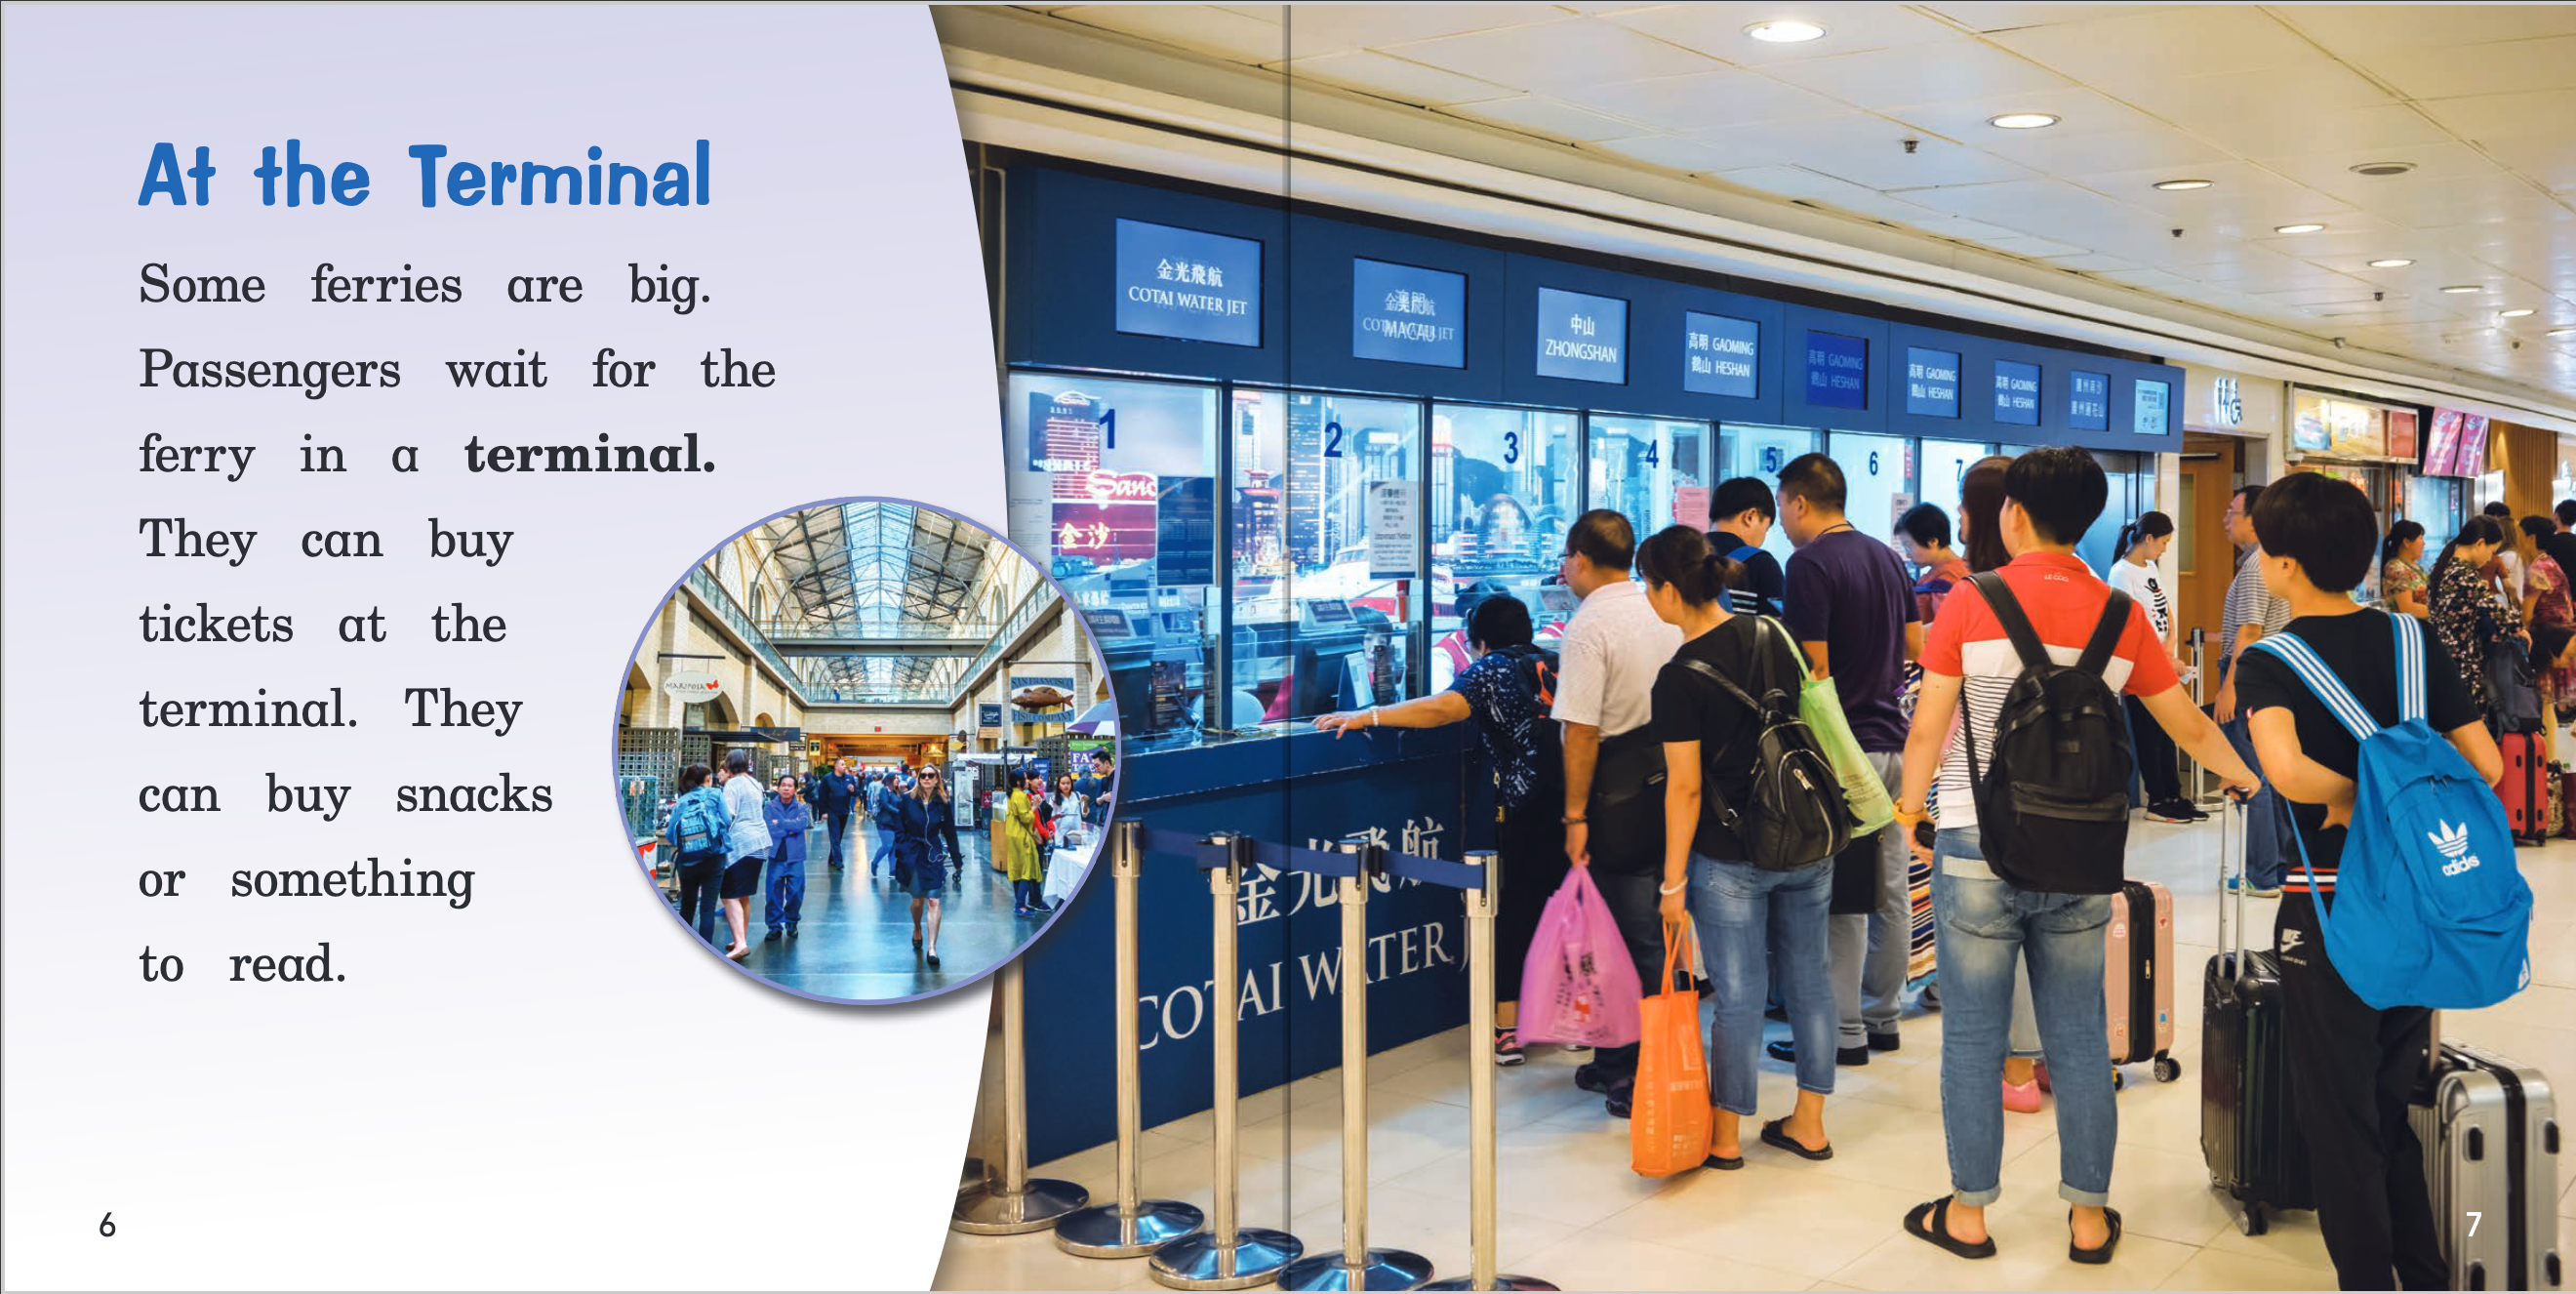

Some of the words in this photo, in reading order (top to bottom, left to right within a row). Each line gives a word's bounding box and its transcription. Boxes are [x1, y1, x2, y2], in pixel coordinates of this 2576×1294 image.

[1156, 258, 1224, 288] 金光飛航
[1128, 286, 1173, 305] COTAI
[1177, 292, 1225, 312] WATER
[1226, 300, 1248, 316] JET
[1384, 319, 1435, 343] MACAU
[1570, 313, 1595, 337] 中山
[1545, 338, 1618, 363] ZHONGSHAN
[1711, 337, 1754, 356] GAOMING
[1715, 360, 1751, 378] HESHAN
[1099, 408, 1115, 449] 1
[1324, 422, 1343, 458] 2
[1504, 431, 1518, 464] 3
[1645, 439, 1659, 468] 4
[1765, 446, 1777, 473] 5
[1870, 451, 1878, 476] 6
[1955, 459, 1963, 482] 7
[1058, 521, 1110, 549] 金沙
[1028, 677, 1073, 691] FRANCISCO
[1012, 710, 1031, 722] FISH
[1032, 711, 1073, 722] COMPANY
[1298, 921, 1456, 1002] WTER
